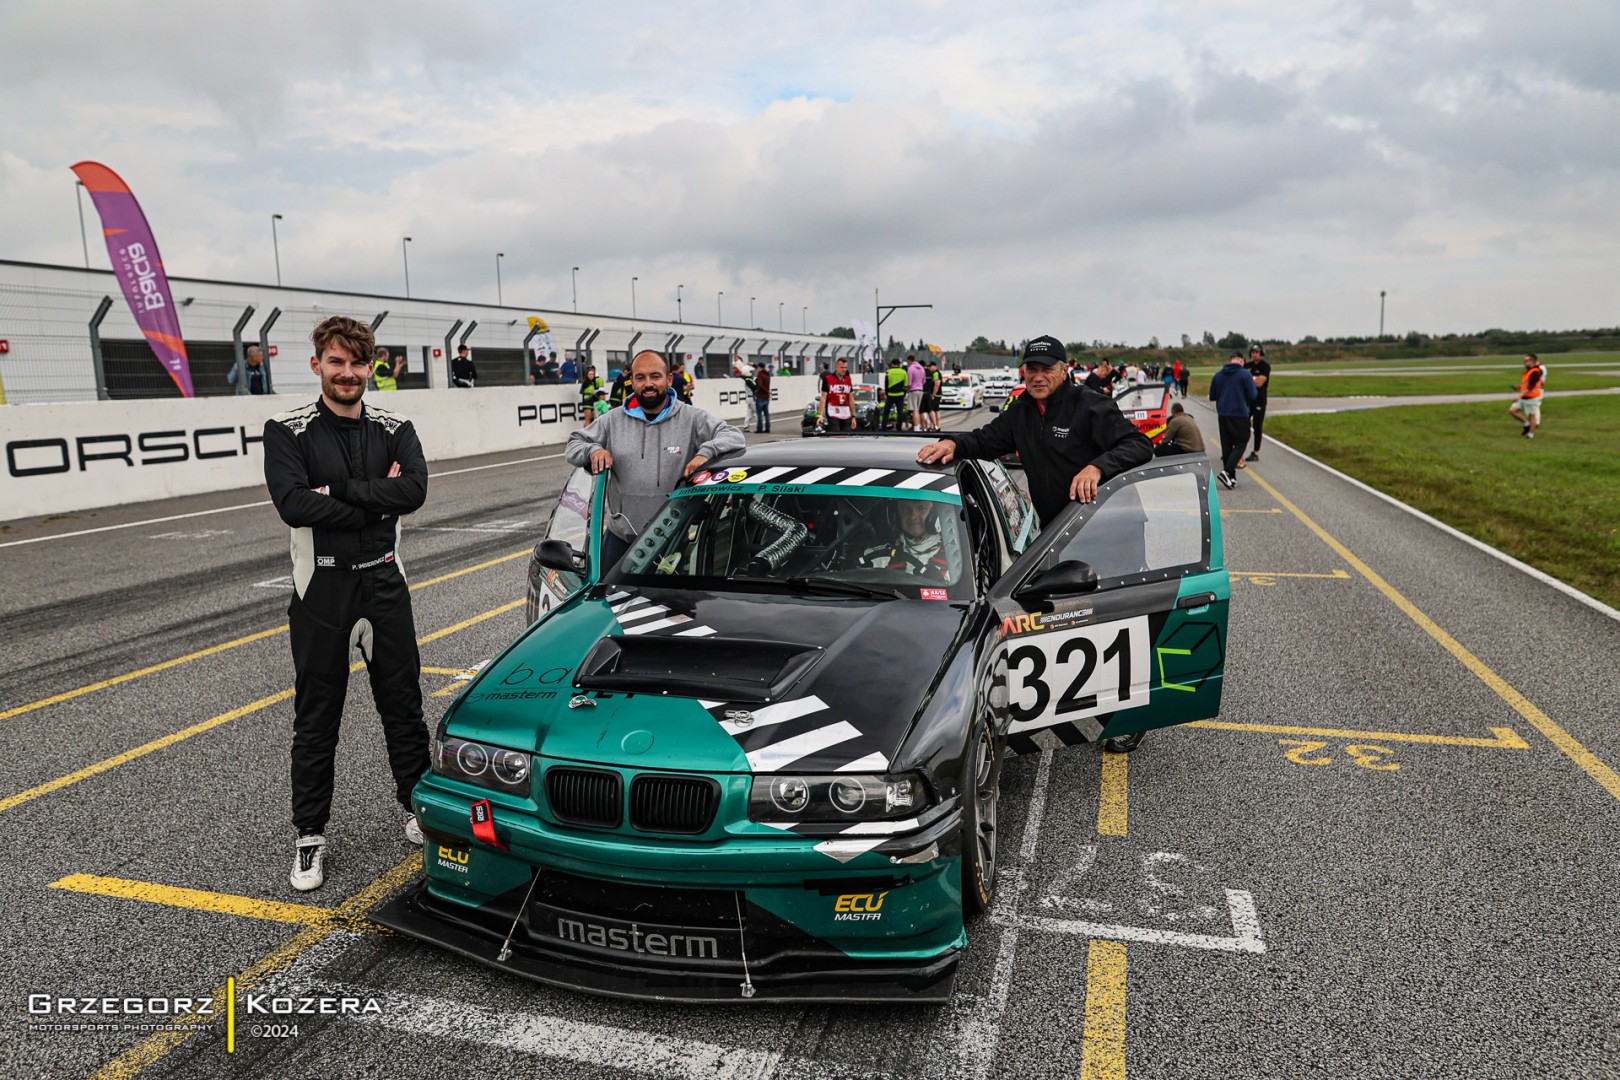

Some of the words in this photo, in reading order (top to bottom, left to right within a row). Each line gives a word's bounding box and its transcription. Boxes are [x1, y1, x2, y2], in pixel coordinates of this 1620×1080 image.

[771, 485, 805, 493] Silski
[1002, 611, 1045, 637] ARC
[1007, 628, 1131, 722] 321
[485, 690, 557, 700] masterm
[1278, 738, 1400, 770] 32
[437, 859, 468, 874] MASTER
[834, 891, 889, 912] ECU
[558, 917, 718, 958] masterm
